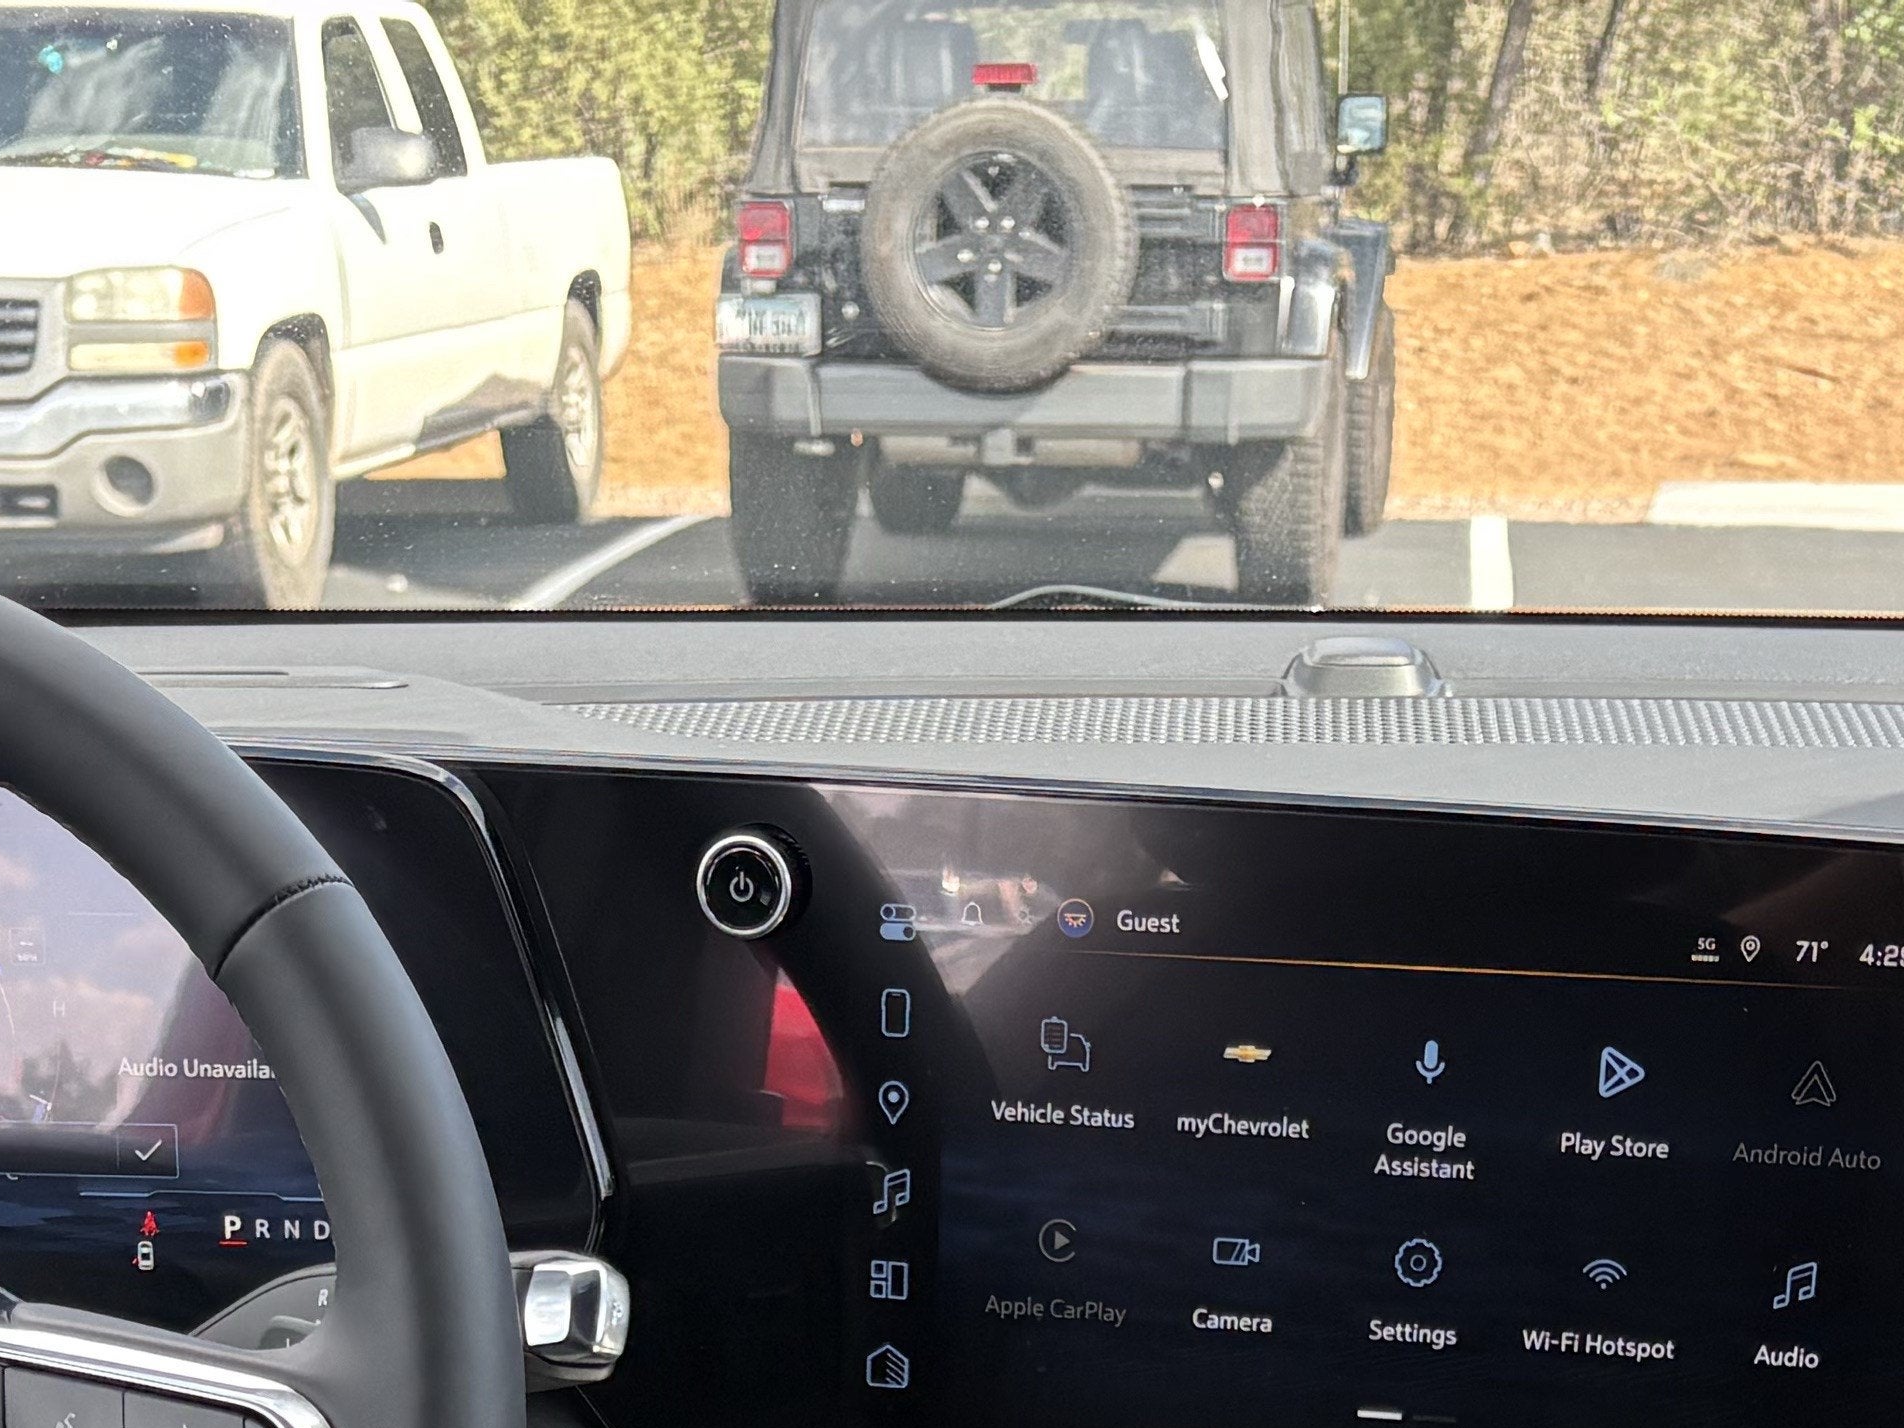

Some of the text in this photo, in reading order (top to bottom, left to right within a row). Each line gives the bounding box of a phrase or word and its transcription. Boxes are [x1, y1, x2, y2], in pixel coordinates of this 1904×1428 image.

[1116, 909, 1181, 935] Guest
[1697, 937, 1716, 951] 5G
[118, 1057, 275, 1079] Audio Unavaila
[991, 1100, 1135, 1128] Vehicle Status
[1176, 1112, 1309, 1141] myChevrolet
[1387, 1124, 1466, 1151] Google
[1560, 1132, 1669, 1161] Play Store
[1373, 1155, 1475, 1181] Assistant
[1732, 1143, 1881, 1170] Android Auto
[224, 1215, 330, 1240] P R N D
[985, 1295, 1126, 1327] Apple CarPlay
[1192, 1309, 1273, 1333] Camera
[1368, 1320, 1457, 1349] Settings
[1522, 1329, 1675, 1361] Wi-Fi Hotspot
[1753, 1344, 1819, 1369] Audio
